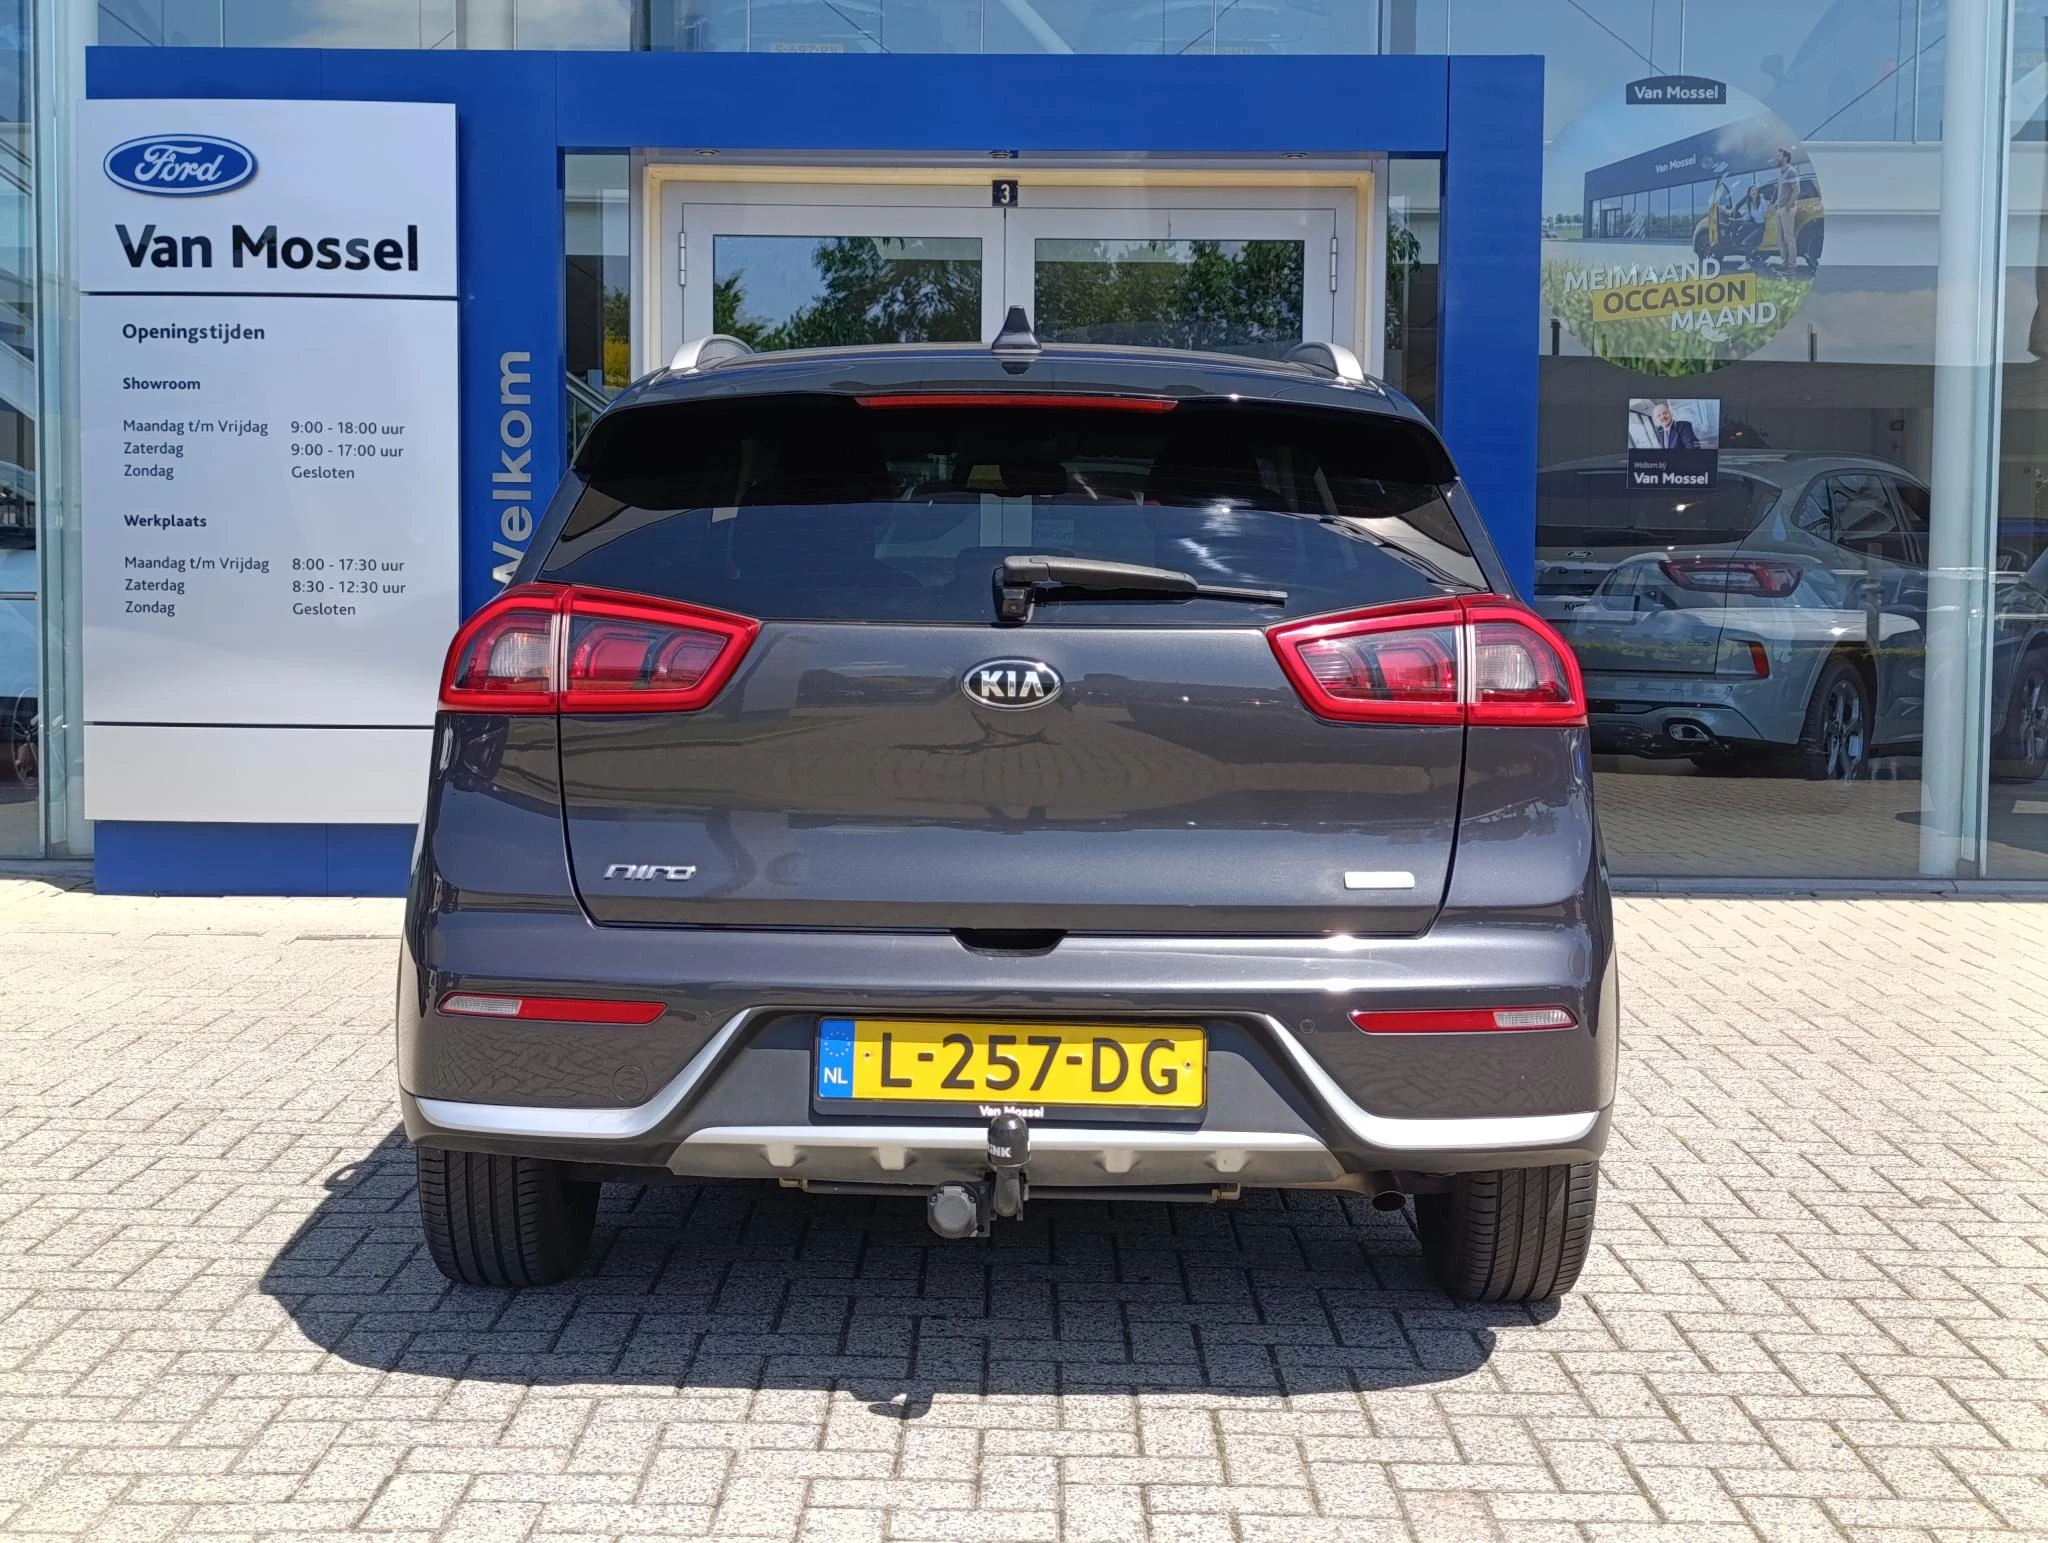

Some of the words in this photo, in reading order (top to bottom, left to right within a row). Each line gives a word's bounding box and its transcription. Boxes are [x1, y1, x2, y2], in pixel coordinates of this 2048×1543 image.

[1634, 86, 1662, 99] Van
[1667, 86, 1719, 99] Mossel
[134, 144, 224, 181] Ford
[1655, 163, 1668, 175] Van
[1669, 154, 1697, 171] Mossel
[1001, 183, 1010, 204] 3
[115, 224, 212, 268] Van
[232, 224, 419, 271] Mossel
[1564, 258, 1721, 293] MEIMAAND
[1603, 280, 1746, 314] OCCASION
[1671, 302, 1777, 332] MAAND
[122, 323, 266, 344] Openingstijden
[122, 377, 201, 390] Showroom
[123, 420, 185, 436] Maandag
[188, 420, 214, 433] t/m
[218, 420, 269, 437] Vrijdag
[291, 421, 323, 434] 9:00
[337, 422, 378, 435] 18:00
[381, 424, 406, 435] uur
[123, 442, 184, 458] Zaterdag
[291, 443, 323, 456] 9:00
[337, 444, 376, 457] 17:00
[380, 447, 404, 458] uur
[123, 465, 175, 481] Zondag
[291, 465, 355, 479] Gesloten
[1634, 472, 1658, 484] Van
[1662, 472, 1709, 484] Mossel
[124, 514, 207, 530] Werkplaats
[125, 556, 186, 573] Maandag
[189, 556, 215, 570] t/m
[219, 557, 270, 574] Vrijdag
[292, 558, 325, 571] 8:00
[338, 558, 377, 572] 17:30
[381, 561, 405, 572] uur
[125, 578, 186, 595] Zaterdag
[292, 581, 325, 593] 8:30
[338, 581, 378, 594] 12:30
[382, 584, 406, 594] uur
[125, 601, 176, 617] Zondag
[292, 602, 356, 616] Gesloten
[980, 670, 1044, 697] KIA
[880, 1031, 1178, 1095] L-257-DG
[823, 1067, 848, 1085] NL
[979, 1105, 1001, 1117] Van
[1004, 1105, 1044, 1117] Mossel
